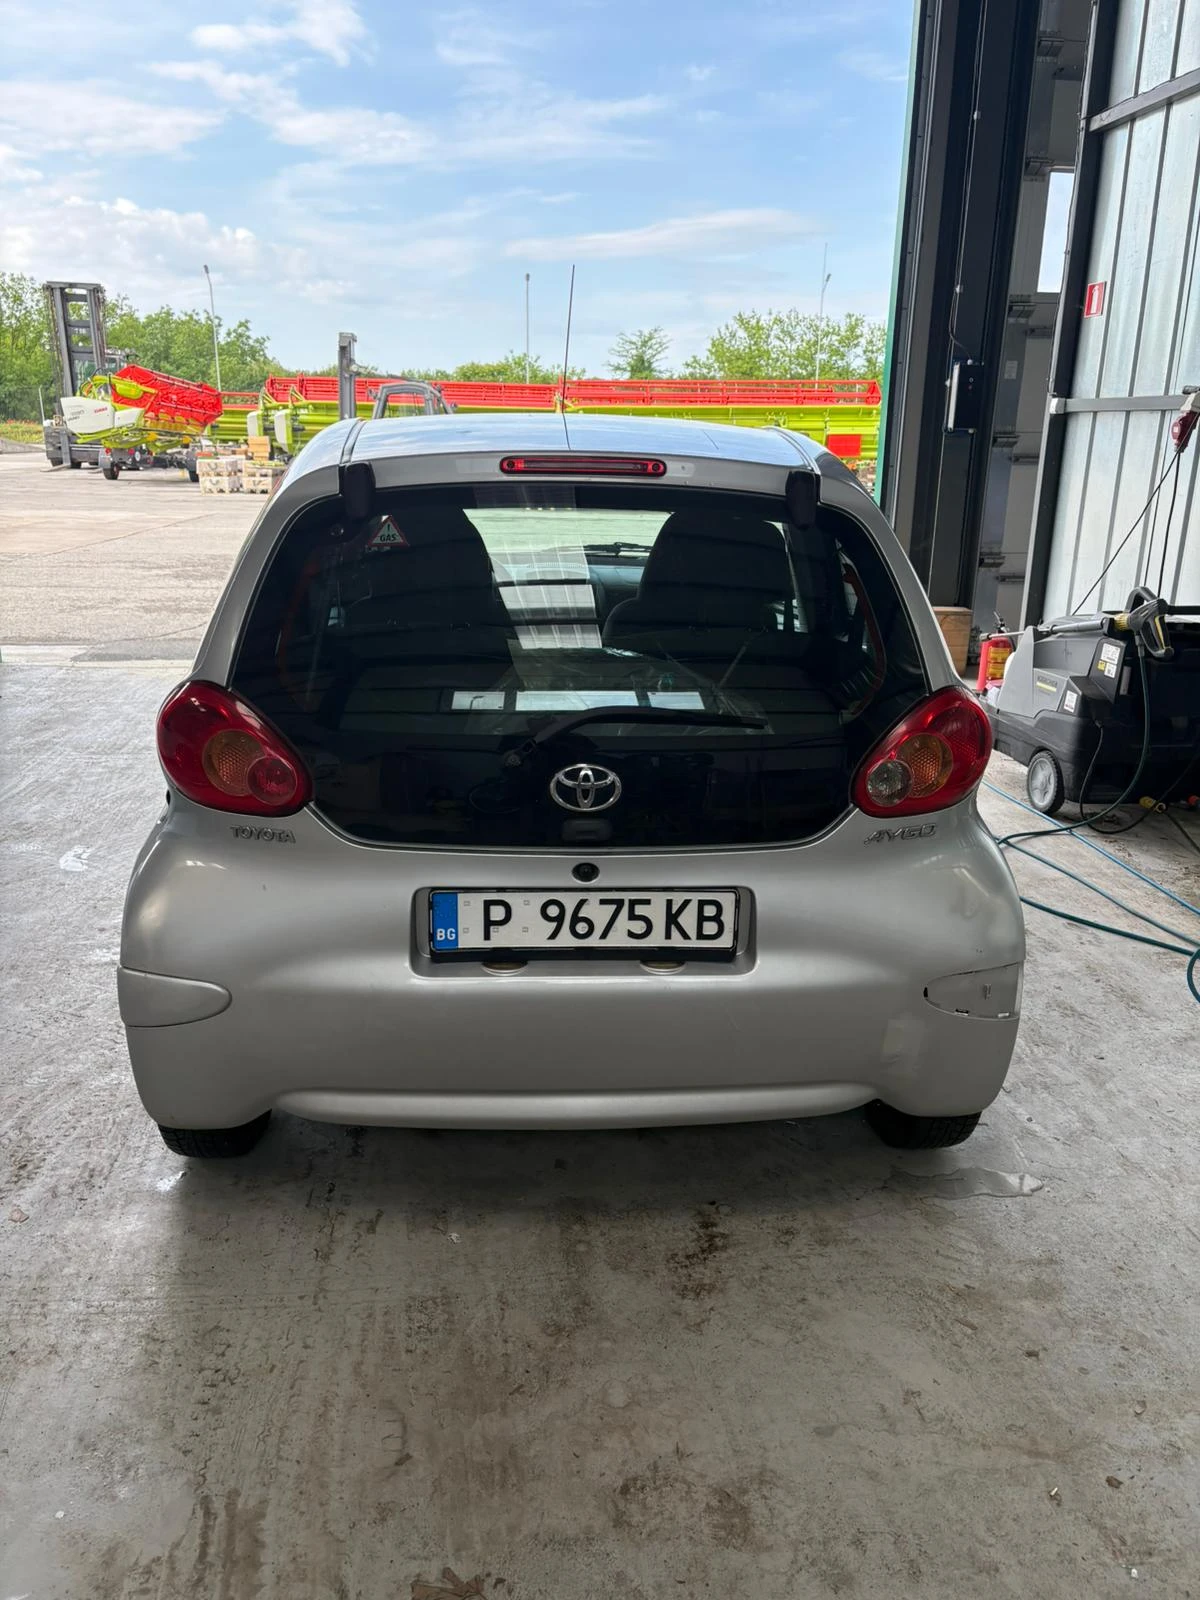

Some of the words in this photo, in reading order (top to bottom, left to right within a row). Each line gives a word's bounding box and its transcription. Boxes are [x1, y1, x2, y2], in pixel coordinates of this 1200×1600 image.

[380, 533, 397, 542] GAS
[230, 824, 296, 844] TOYOTA
[864, 823, 936, 847] AYGO
[436, 928, 456, 941] BG
